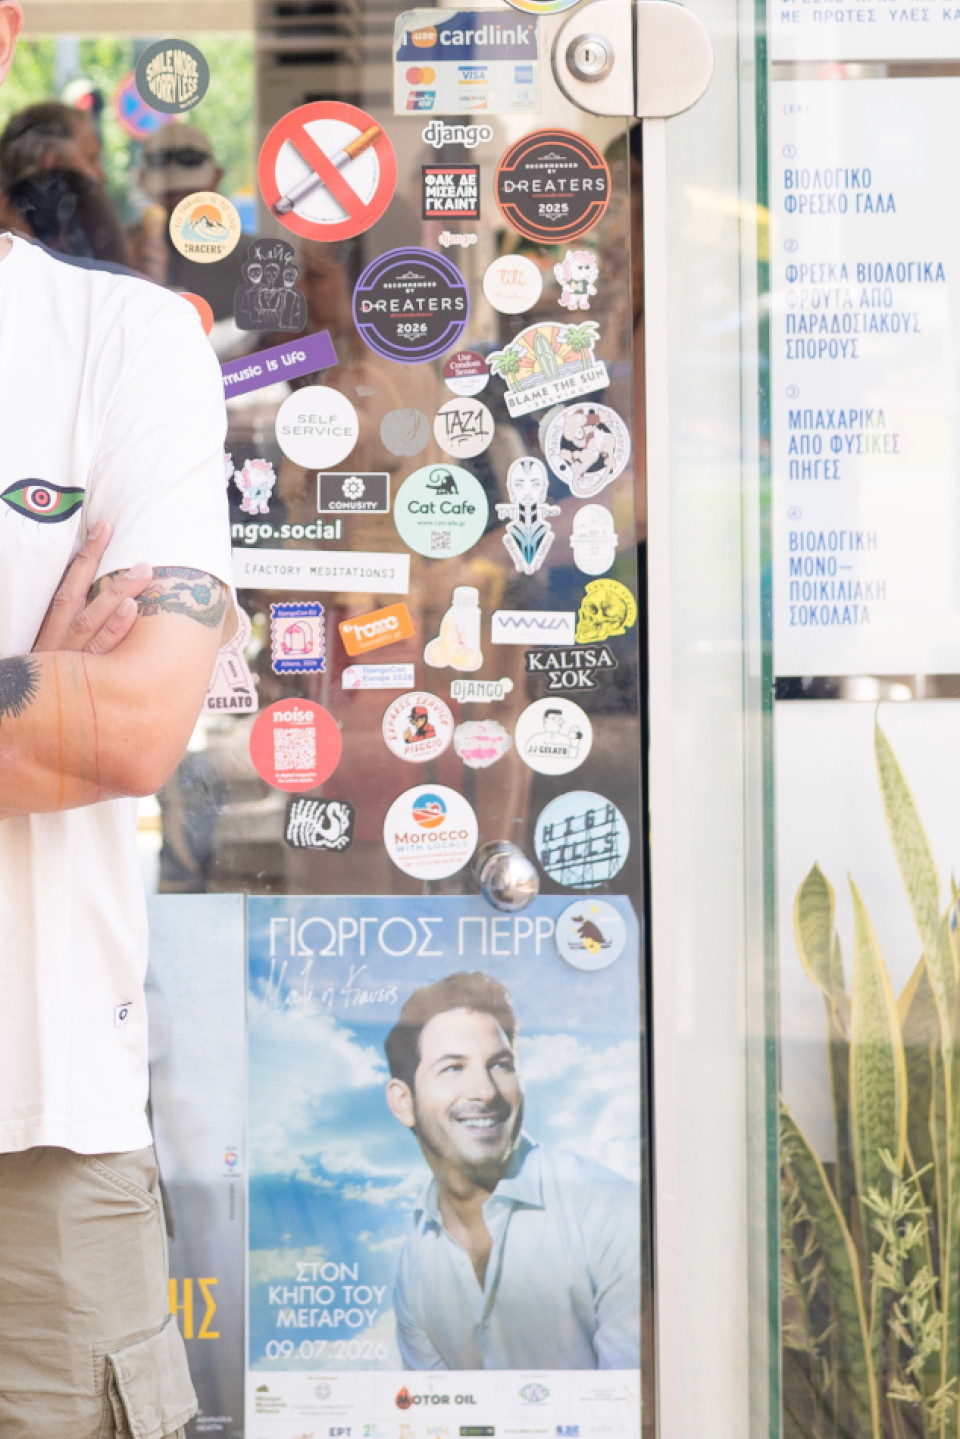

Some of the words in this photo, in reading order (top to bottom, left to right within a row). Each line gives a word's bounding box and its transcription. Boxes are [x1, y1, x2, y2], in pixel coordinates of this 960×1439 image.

[780, 10, 801, 24] ΜΕ
[813, 9, 876, 23] ΠΡΩΤΕΣ
[889, 8, 931, 22] ΥΛΕΣ
[413, 31, 435, 41] use
[440, 24, 529, 46] cardlink
[462, 71, 485, 79] VISA
[424, 122, 491, 146] django
[424, 174, 454, 186] ΦΑΚ
[459, 174, 477, 186] ΔΕ
[784, 168, 872, 190] ΒΙΟΛΟΓΙΚΟ
[426, 186, 477, 197] ΜΙΣΕΛΙΝ
[426, 197, 477, 210] ΓΚΑΙΝΤ
[538, 203, 569, 213] 2025
[784, 194, 848, 214] ΦΡΕΣΚΟ
[856, 193, 896, 213] ΓΑΛΑ
[786, 263, 850, 283] ΦΡΕΣΚΑ
[856, 262, 946, 283] ΒΙΟΛΟΓΙΚΑ
[786, 288, 852, 309] ΦΡΟΥΤΑ
[860, 288, 892, 308] ΑΠΟ
[396, 323, 428, 333] 2026
[786, 312, 921, 334] ΠΑΡΑΔΟΣΙΑΚΟΥΣ
[786, 339, 859, 359] ΣΠΟΡΟΥΣ
[266, 359, 279, 372] is
[508, 387, 549, 408] BLAME
[552, 378, 577, 392] THE
[580, 369, 605, 384] SUN
[297, 414, 338, 424] SELF
[789, 409, 886, 430] ΜΠΑΧΑΡΙΚΑ
[282, 426, 353, 437] SERVICE
[788, 435, 822, 455] ΑΠΟ
[830, 434, 900, 455] ΦΥΣΙΚΕΣ
[789, 460, 841, 480] ΠΗΓΕΣ
[407, 500, 436, 514] Cat
[439, 499, 476, 515] Cafe
[789, 531, 877, 551] ΒΙΟΛΟΓΙΚΗ
[789, 580, 886, 601] ΠΟΙΚΙΛΙΑΚΗ
[789, 605, 870, 625] ΣΟΚΟΛΑΤΑ
[528, 649, 613, 670] KALTSA
[549, 669, 594, 689] ΣΟΚ
[208, 696, 252, 709] GELATO
[273, 707, 314, 722] noise
[543, 804, 616, 842] HIGH
[395, 830, 468, 845] Morocco
[270, 917, 443, 956] ΓΙΩΡΓΟΣ
[458, 917, 560, 956] ΠΕΡΡ
[295, 1262, 359, 1282] ΣΤΟΝ
[268, 1285, 335, 1305] ΚΗΠΟ
[343, 1285, 387, 1305] ΤΟΥ
[276, 1308, 378, 1328] ΜΕΓΑΡΟΥ
[266, 1339, 388, 1361] 09.07.2026
[395, 1394, 450, 1405] MOTOR
[454, 1394, 477, 1405] OIL
